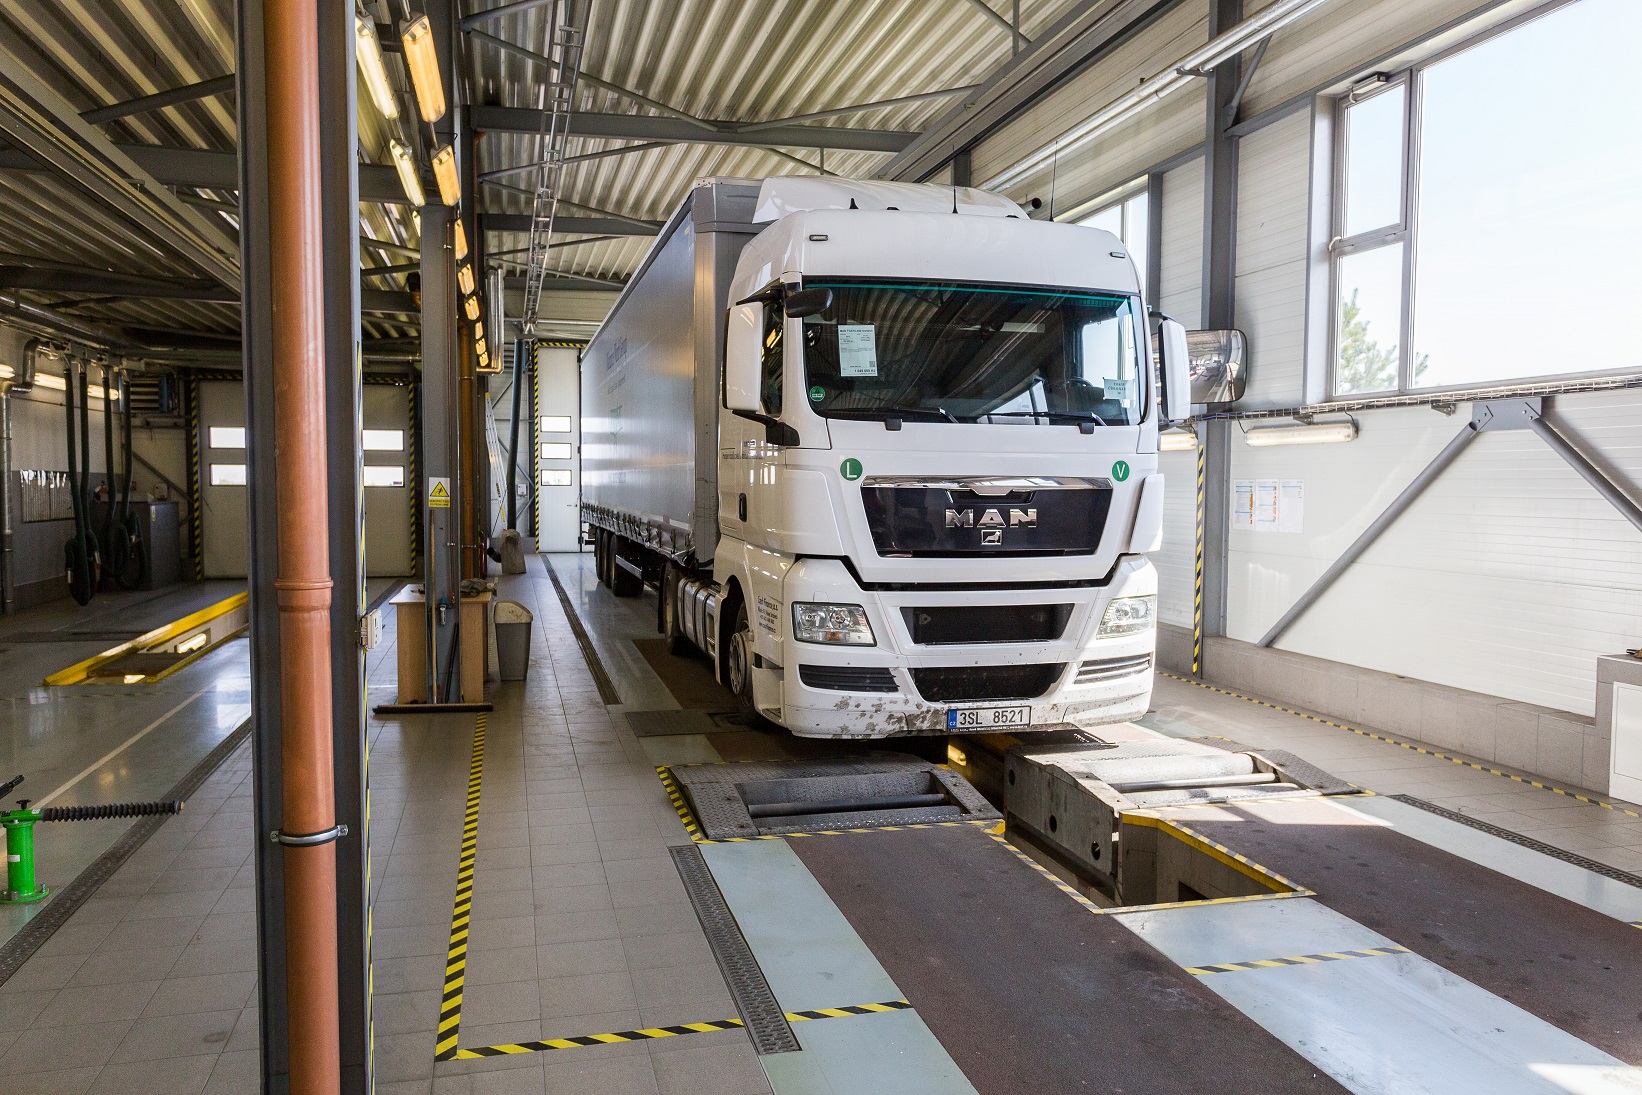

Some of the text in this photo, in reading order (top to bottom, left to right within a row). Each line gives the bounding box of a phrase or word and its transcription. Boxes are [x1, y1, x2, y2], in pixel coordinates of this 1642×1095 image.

[846, 462, 857, 478] L
[1116, 464, 1126, 479] V
[945, 508, 1037, 528] MAN
[959, 709, 1023, 725] 3SL 8521
